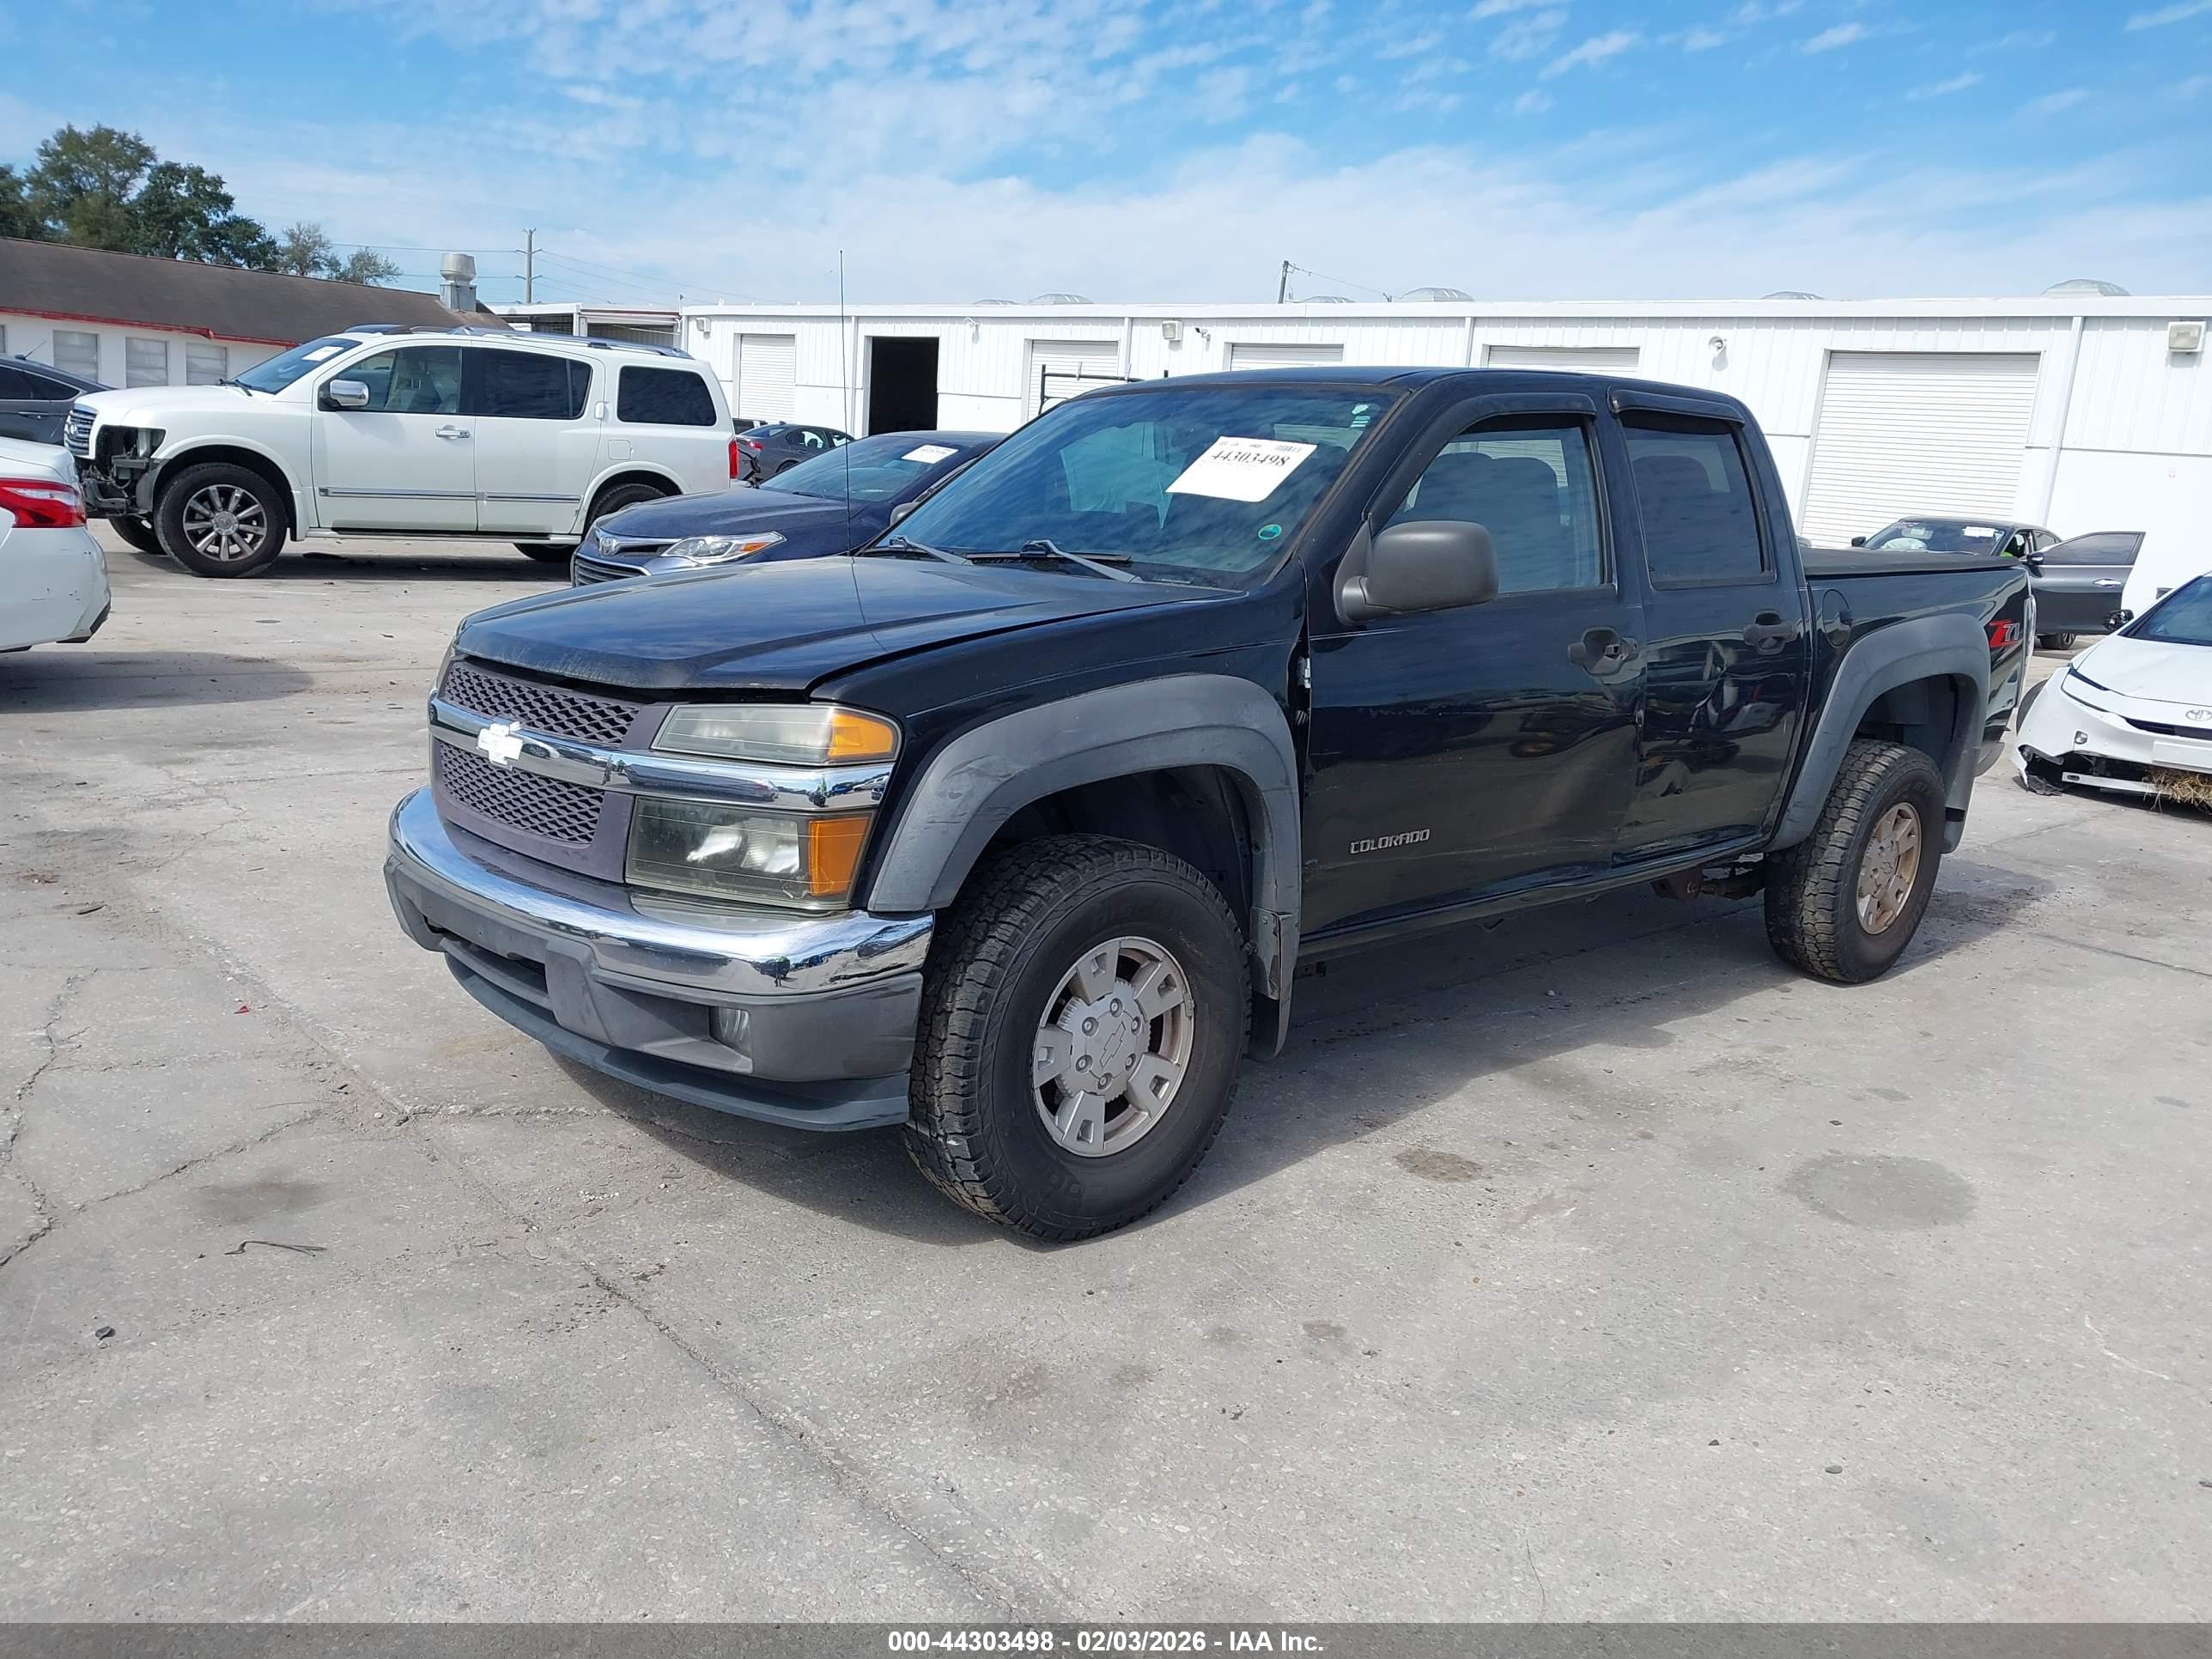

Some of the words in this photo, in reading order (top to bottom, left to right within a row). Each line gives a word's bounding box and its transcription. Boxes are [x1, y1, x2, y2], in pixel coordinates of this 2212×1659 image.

[1211, 450, 1291, 466] 44303498
[1989, 619, 2021, 648] Z71
[1350, 828, 1431, 854] COLORADO
